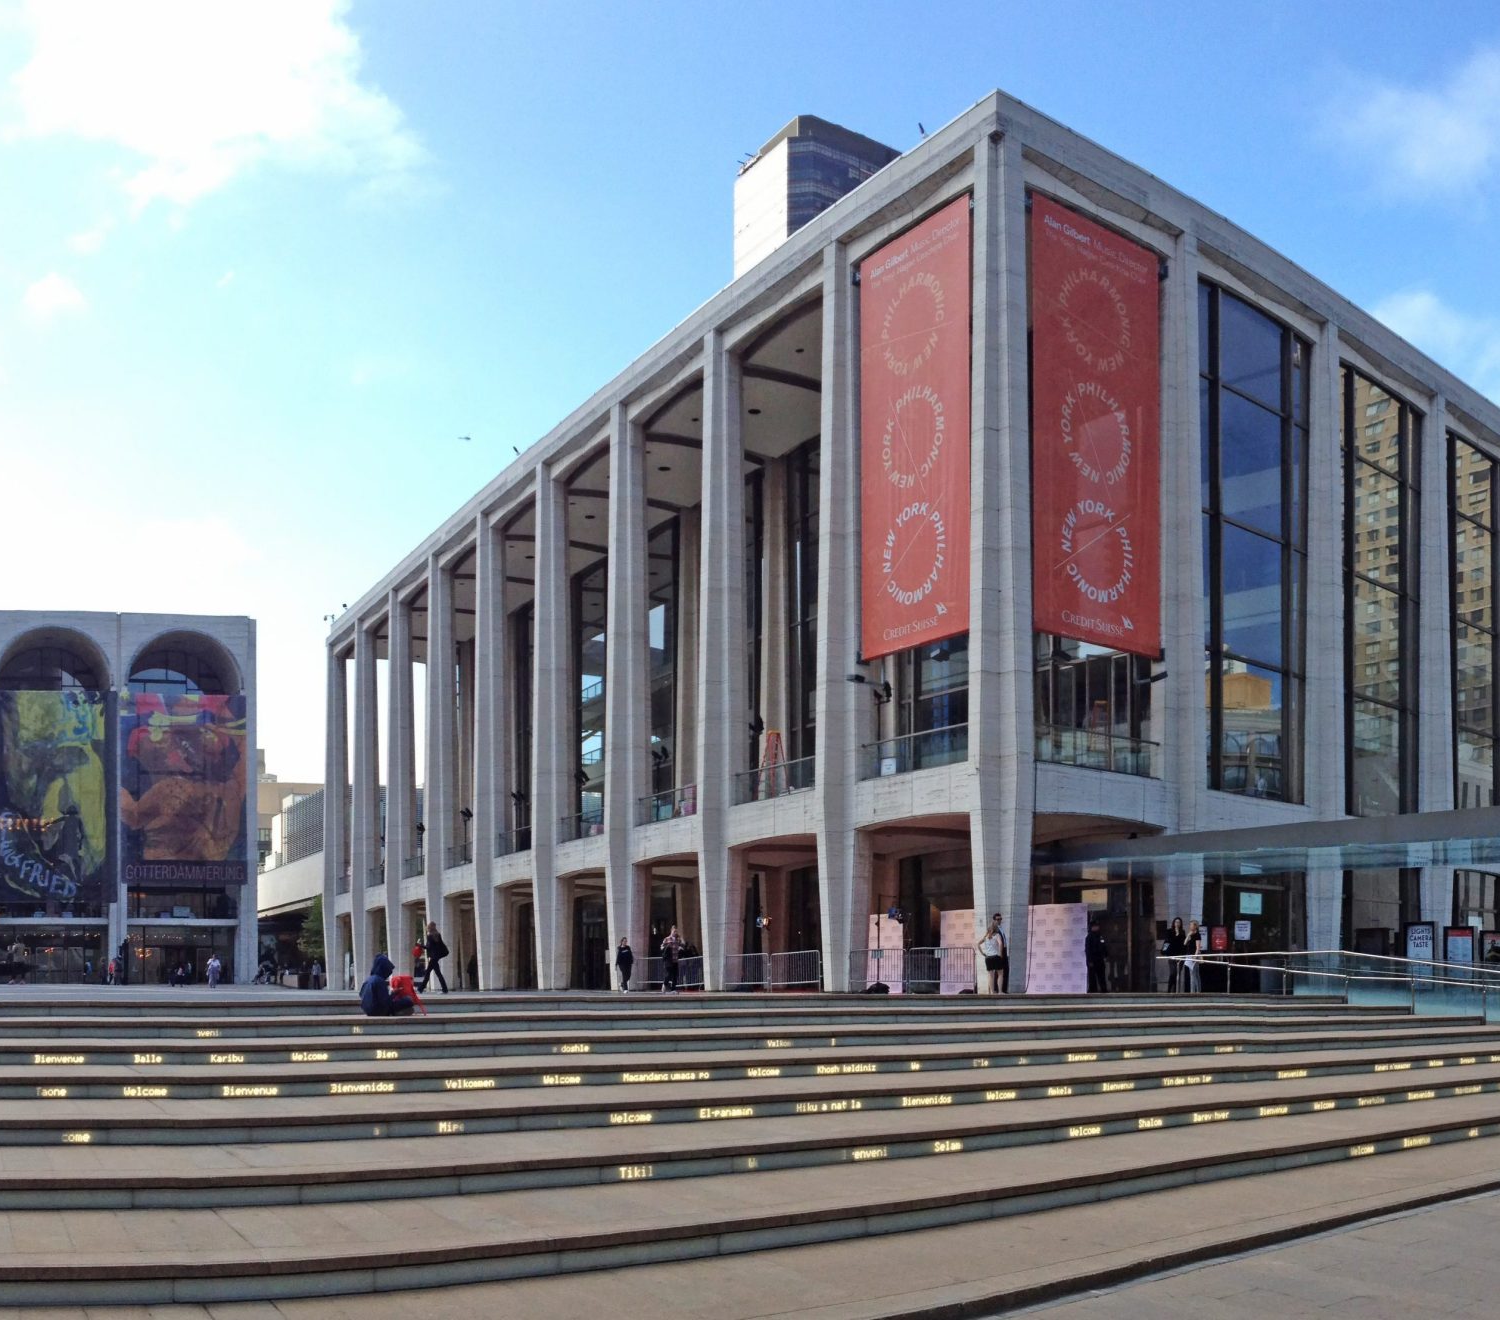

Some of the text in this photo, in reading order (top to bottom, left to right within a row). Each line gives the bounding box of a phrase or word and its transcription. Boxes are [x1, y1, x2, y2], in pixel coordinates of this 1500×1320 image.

[1044, 214, 1062, 229] Alan
[1063, 223, 1092, 245] Gilbert
[885, 248, 909, 270] Gilbert
[881, 272, 945, 340] PHILHARMONIC
[1060, 267, 1131, 349] PHILHARMONIC
[1062, 317, 1124, 372] NEW YORK
[884, 332, 939, 377] NEW YORK
[895, 385, 945, 478] PHILHARMONIC
[1060, 391, 1100, 484] NEW YORK
[1077, 381, 1132, 485] PHILHARMONIC
[882, 416, 916, 489] NEW YORK
[1077, 499, 1116, 524] YORK
[1060, 507, 1078, 553] NEW
[883, 501, 947, 606] NEW YORK PHILHARMONIC
[1066, 526, 1134, 604] PHILHARMONIC
[883, 615, 939, 641] CREDIT SUISSE
[1061, 609, 1125, 637] CREDIT SUISSE
[34, 1054, 84, 1064] Bienvenue
[210, 1054, 244, 1063] Karibu
[292, 1052, 328, 1061] Welcome
[376, 1050, 398, 1059] Bien
[1068, 1054, 1098, 1062] Bienvenue
[748, 1068, 781, 1078] Welcome
[816, 1065, 840, 1074] Khosh
[445, 1078, 495, 1090] Velkommen
[543, 1075, 581, 1085] Welcome
[123, 1086, 168, 1096] Welcome
[222, 1086, 278, 1096] Bienvenue
[330, 1082, 394, 1094] Bienvenidos
[1102, 1082, 1134, 1092] Bienvenue
[902, 1094, 952, 1105] Bienvenidos
[986, 1090, 1016, 1100] Welcome
[1314, 1101, 1336, 1110] Welcome
[610, 1113, 653, 1124] Welcome
[1138, 1118, 1163, 1129] Shalom
[1069, 1126, 1101, 1138] Welcome
[934, 1141, 964, 1152] Selam
[1350, 1145, 1375, 1156] Welcome
